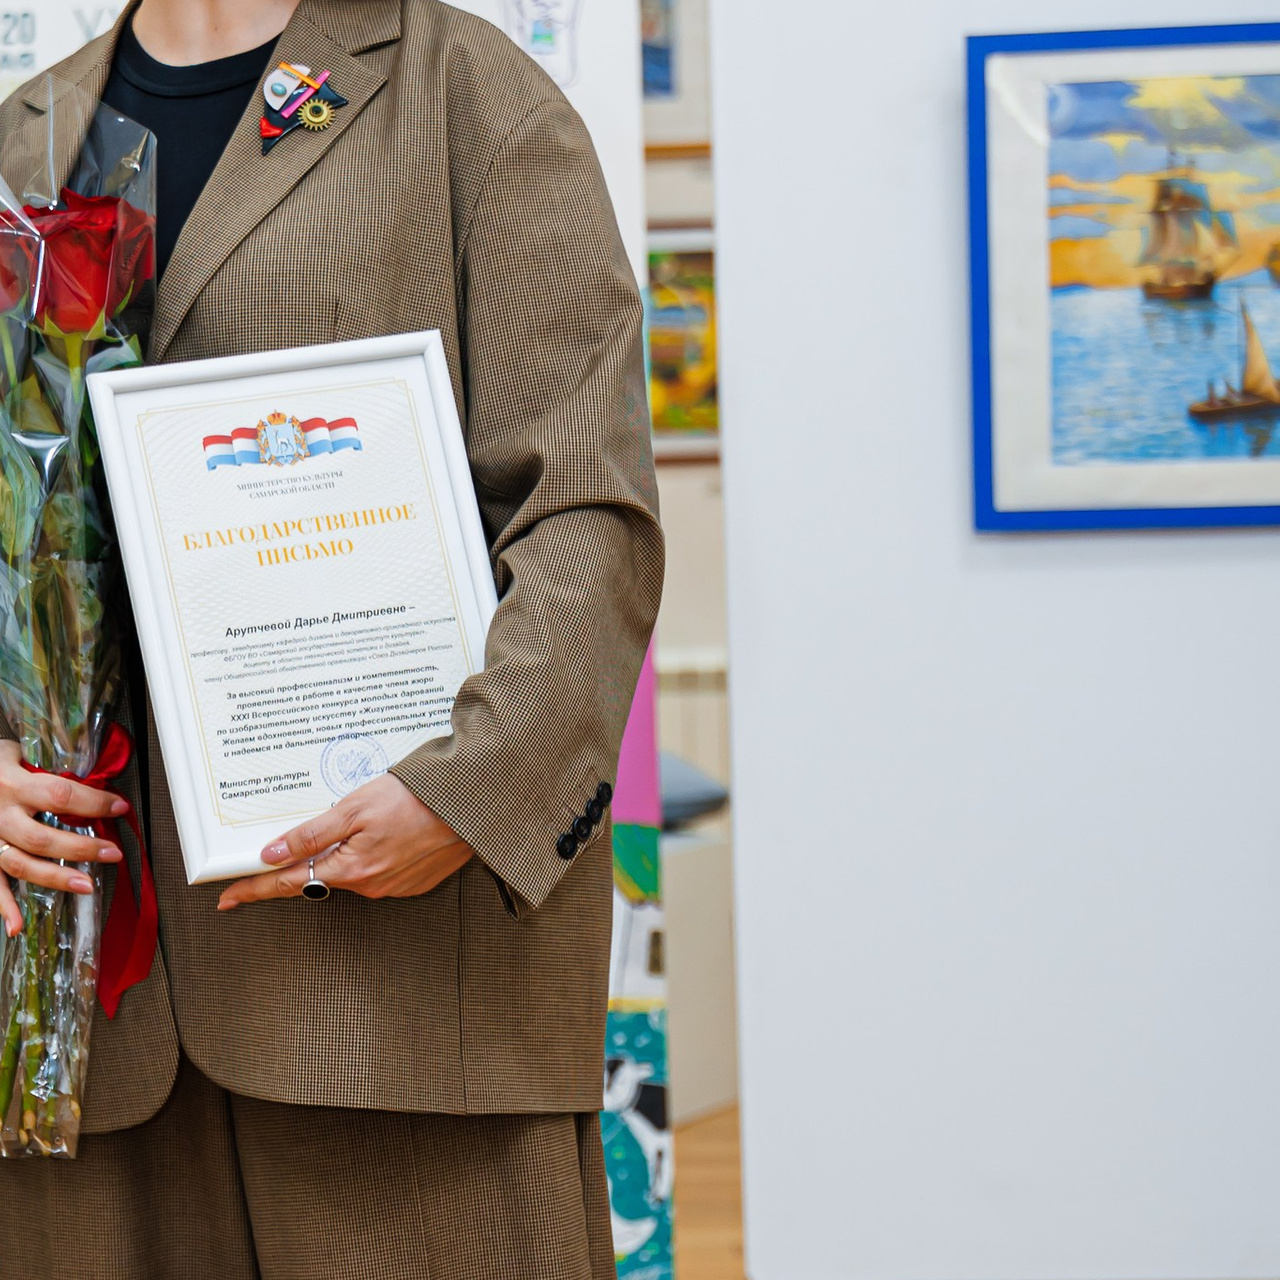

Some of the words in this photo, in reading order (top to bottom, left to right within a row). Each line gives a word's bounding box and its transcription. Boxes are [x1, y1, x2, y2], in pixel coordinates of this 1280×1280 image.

[184, 503, 416, 551] БЛАГОДАРСТВЕННОЕ
[258, 538, 353, 567] ПИСЬМО
[226, 619, 290, 639] Арутчевой
[294, 614, 329, 629] Дарье
[332, 603, 406, 624] Дмитриевне
[227, 692, 237, 701] За
[239, 687, 274, 699] высокий
[277, 676, 353, 693] профессионализм
[231, 713, 250, 723] XXXI
[252, 703, 319, 720] Всероссийского
[322, 698, 358, 710] конкурса
[361, 692, 398, 705] молодых
[401, 686, 444, 699] дарований
[237, 697, 293, 711] проявленные
[303, 690, 334, 701] работе
[344, 683, 383, 695] качестве
[386, 680, 408, 689] члена
[412, 676, 434, 686] жюри
[223, 735, 255, 746] Желаем
[316, 723, 342, 733] новых
[345, 711, 426, 729] профессиональных
[428, 707, 451, 717] успех
[230, 716, 310, 734] изобразительному
[313, 711, 357, 723] искусству
[360, 701, 417, 716] «Жигулевская
[420, 696, 456, 708] палитра
[232, 744, 271, 756] надеемся
[286, 735, 336, 749] дальнейшее
[338, 727, 388, 741] творческое
[220, 777, 261, 790] Министр
[264, 770, 310, 784] культуры
[222, 786, 270, 800] Самарской
[273, 780, 312, 793] области
